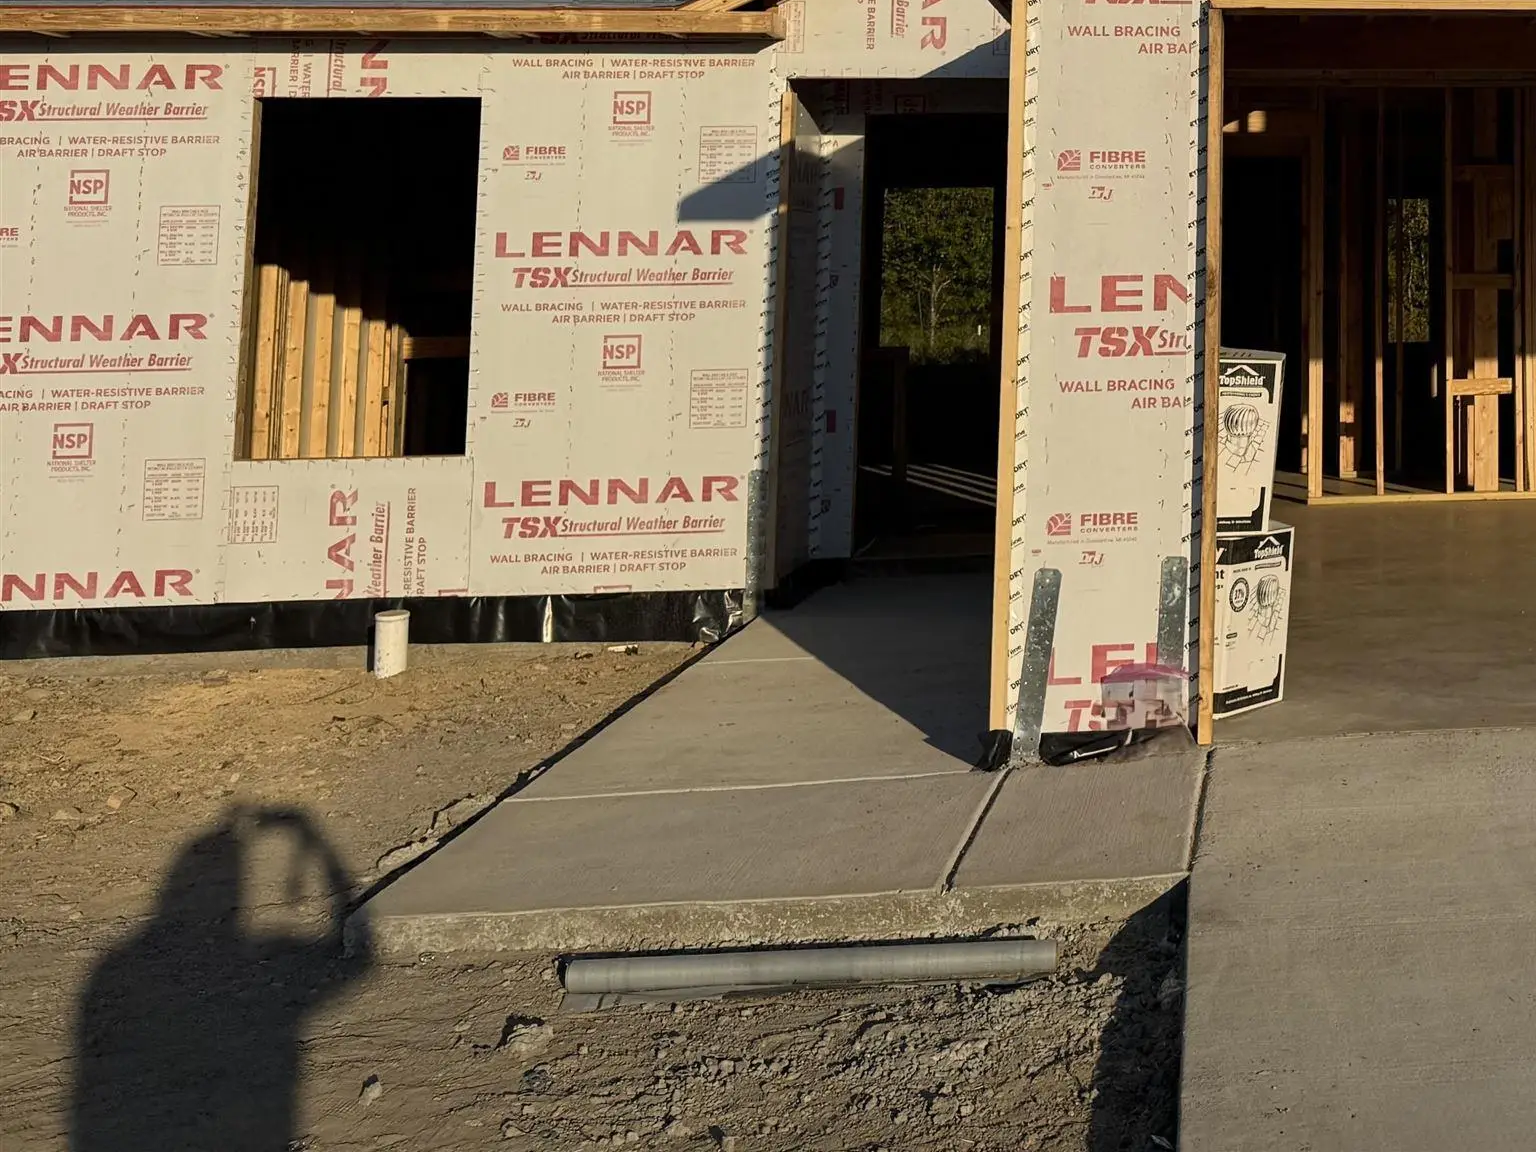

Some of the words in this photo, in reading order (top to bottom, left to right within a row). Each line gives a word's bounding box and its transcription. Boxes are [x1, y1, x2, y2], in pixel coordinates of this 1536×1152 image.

[895, 0, 910, 38] Barrier
[866, 7, 877, 50] BARRIER
[1068, 25, 1110, 38] WALL
[1114, 25, 1181, 38] BRACING
[1138, 43, 1163, 55] AIR
[512, 59, 543, 68] WALL
[545, 59, 594, 68] BRACING
[610, 58, 706, 68] WATER-RESISTIVE
[709, 58, 755, 67] BARRIER
[0, 64, 224, 91] ENNAR
[562, 71, 581, 80] AIR
[583, 71, 630, 80] BARRIER
[639, 70, 675, 80] DRAFT
[677, 70, 705, 79] STOP
[38, 101, 102, 118] Structural
[105, 102, 160, 117] Weather
[163, 101, 209, 118] Barrier
[613, 100, 647, 115] NSP
[0, 136, 51, 146] BRACING
[68, 135, 169, 146] WATER-RESISTIVE
[171, 135, 221, 146] BARRIER
[16, 148, 38, 158] AIR
[39, 148, 89, 158] BARRIER
[97, 148, 135, 158] DRAFT
[137, 147, 167, 157] STOP
[525, 146, 566, 156] FIBRE
[1089, 151, 1146, 163] FIBRE
[69, 179, 105, 195] NSP
[494, 229, 749, 258] LENNAR
[512, 267, 573, 289] TSX
[571, 268, 633, 283] Structural
[636, 268, 688, 282] Weather
[691, 267, 734, 282] Barrier
[501, 303, 533, 312] WALL
[535, 302, 583, 311] BRACING
[600, 300, 697, 311] WATER-RESISTIVE
[699, 300, 746, 309] BARRIER
[552, 314, 571, 323] AIR
[573, 314, 620, 323] BARRIER
[629, 313, 665, 323] DRAFT
[667, 313, 696, 322] STOP
[1074, 326, 1160, 358] TSX
[603, 344, 637, 360] NSP
[20, 354, 85, 370] Structural
[89, 353, 145, 369] Weather
[147, 352, 194, 368] Barrier
[1059, 380, 1102, 393] WALL
[1107, 378, 1175, 392] BRACING
[1219, 374, 1265, 387] TopShield
[51, 386, 153, 399] WATER-RESISTIVE
[155, 385, 206, 397] BARRIER
[514, 392, 556, 402] FIBRE
[0, 402, 19, 412] AIR
[21, 401, 72, 412] BARRIER
[80, 401, 119, 411] DRAFT
[122, 400, 151, 411] STOP
[1131, 397, 1157, 409] AIR
[52, 433, 88, 449] NSP
[483, 475, 740, 508] LENNAR
[405, 488, 417, 534] BARRIER
[368, 500, 387, 543] Barrier
[501, 516, 562, 539] TSX
[561, 517, 622, 533] Structural
[625, 516, 678, 531] Weather
[682, 514, 725, 529] Barrier
[1080, 512, 1138, 526] FIBRE
[417, 537, 427, 564] STOP
[490, 554, 521, 564] WALL
[524, 553, 573, 563] BRACING
[590, 550, 688, 561] WATER-RESISTIVE
[690, 548, 738, 558] BARRIER
[541, 565, 560, 575] AIR
[562, 564, 610, 574] BARRIER
[619, 563, 656, 572] DRAFT
[658, 562, 686, 571] STOP
[1, 569, 196, 602] NNAR
